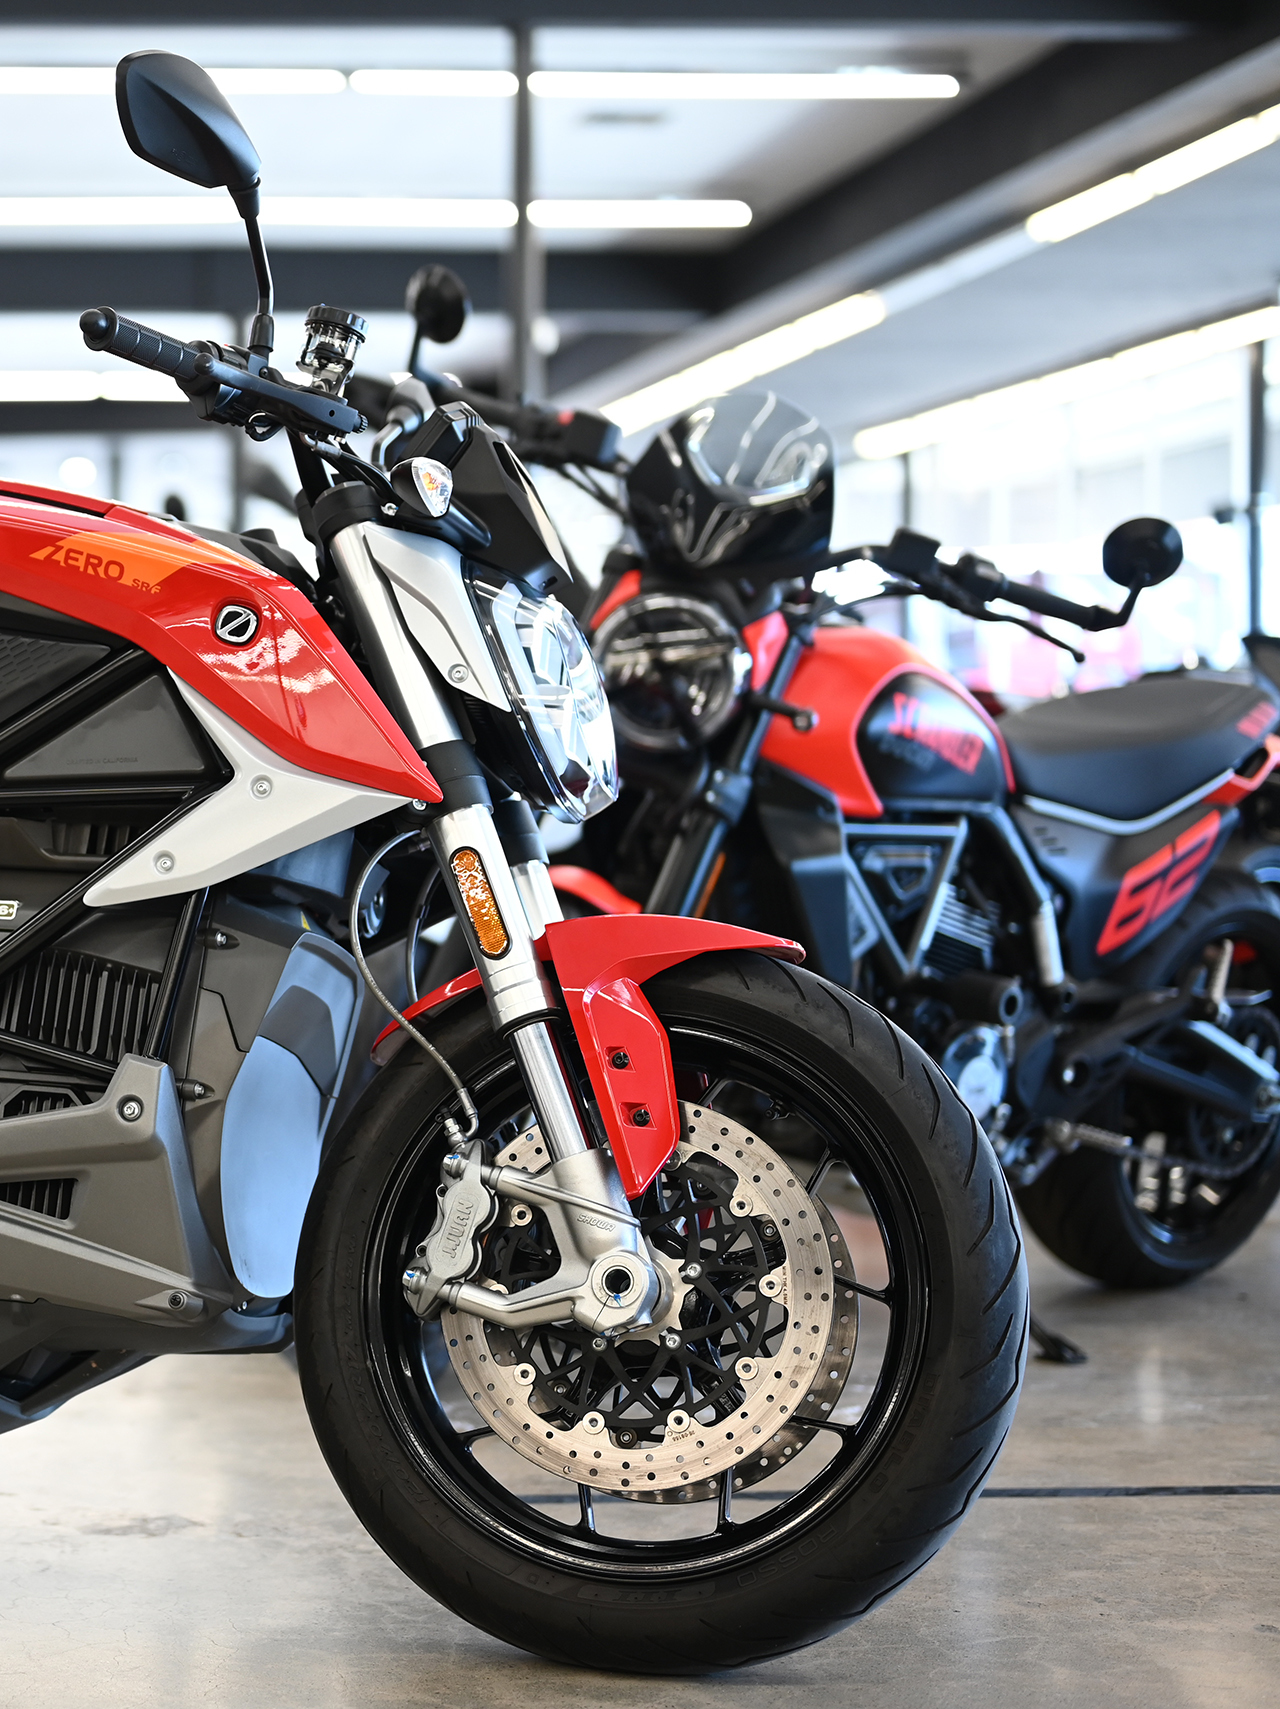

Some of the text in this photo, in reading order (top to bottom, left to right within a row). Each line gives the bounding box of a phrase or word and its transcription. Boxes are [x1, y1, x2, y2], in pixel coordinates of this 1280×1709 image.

[41, 544, 125, 582] ZERO
[1096, 809, 1221, 957] 62
[576, 1213, 617, 1232] SHOWA
[866, 1371, 941, 1496] DIABLO
[736, 1523, 839, 1587] ROSSO
